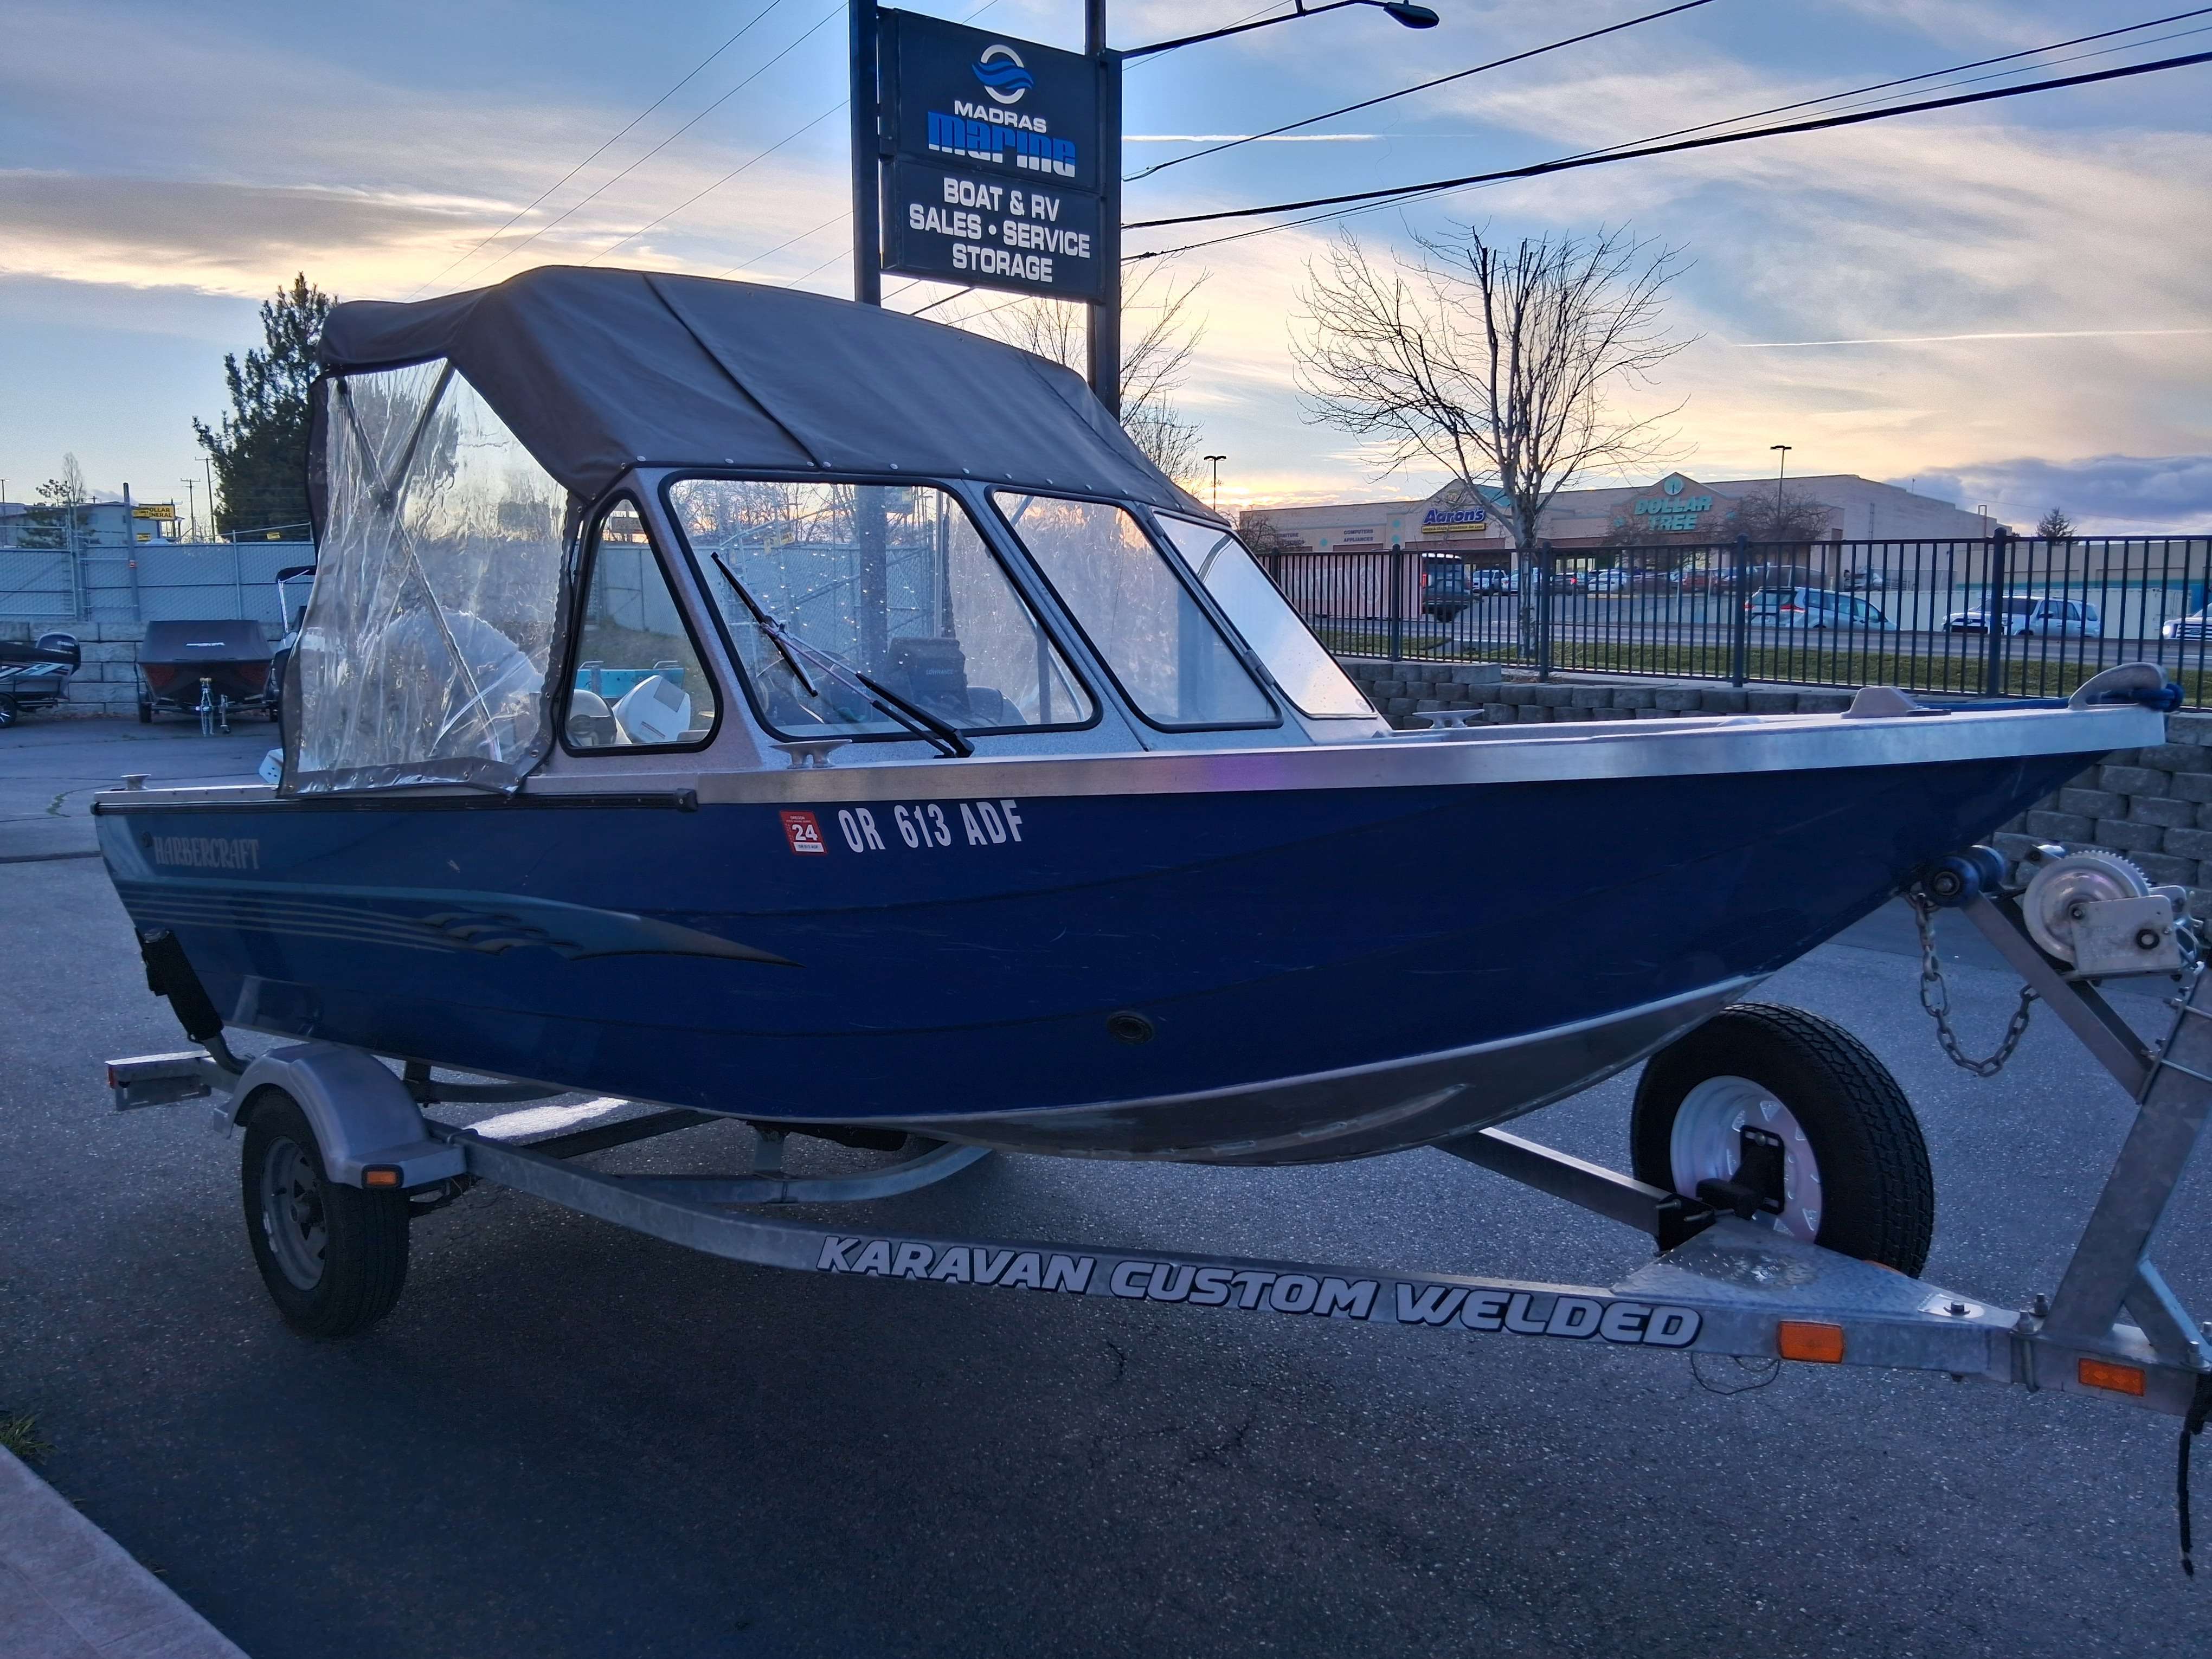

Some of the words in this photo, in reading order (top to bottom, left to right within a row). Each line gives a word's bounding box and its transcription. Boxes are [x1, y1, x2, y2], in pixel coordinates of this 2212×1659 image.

[955, 100, 1046, 133] MADRAS
[928, 111, 1075, 178] marine
[944, 177, 1002, 211] BOAT
[1009, 190, 1025, 216] &
[1031, 195, 1060, 222] RV
[909, 203, 981, 240] SALES
[1003, 220, 1090, 259] SERVICE
[952, 243, 1052, 282] STORAGE
[1423, 507, 1486, 524] Aaron's
[1634, 496, 1713, 515] DOLLAR
[1648, 514, 1697, 530] TREE
[792, 824, 818, 841] 24
[838, 807, 886, 853] OR
[894, 803, 951, 848] 613
[960, 800, 1023, 846] ADF
[816, 1236, 1095, 1294] KARAVAN
[1109, 1261, 1380, 1320] CUSTOM
[1395, 1283, 1703, 1348] WELDED
